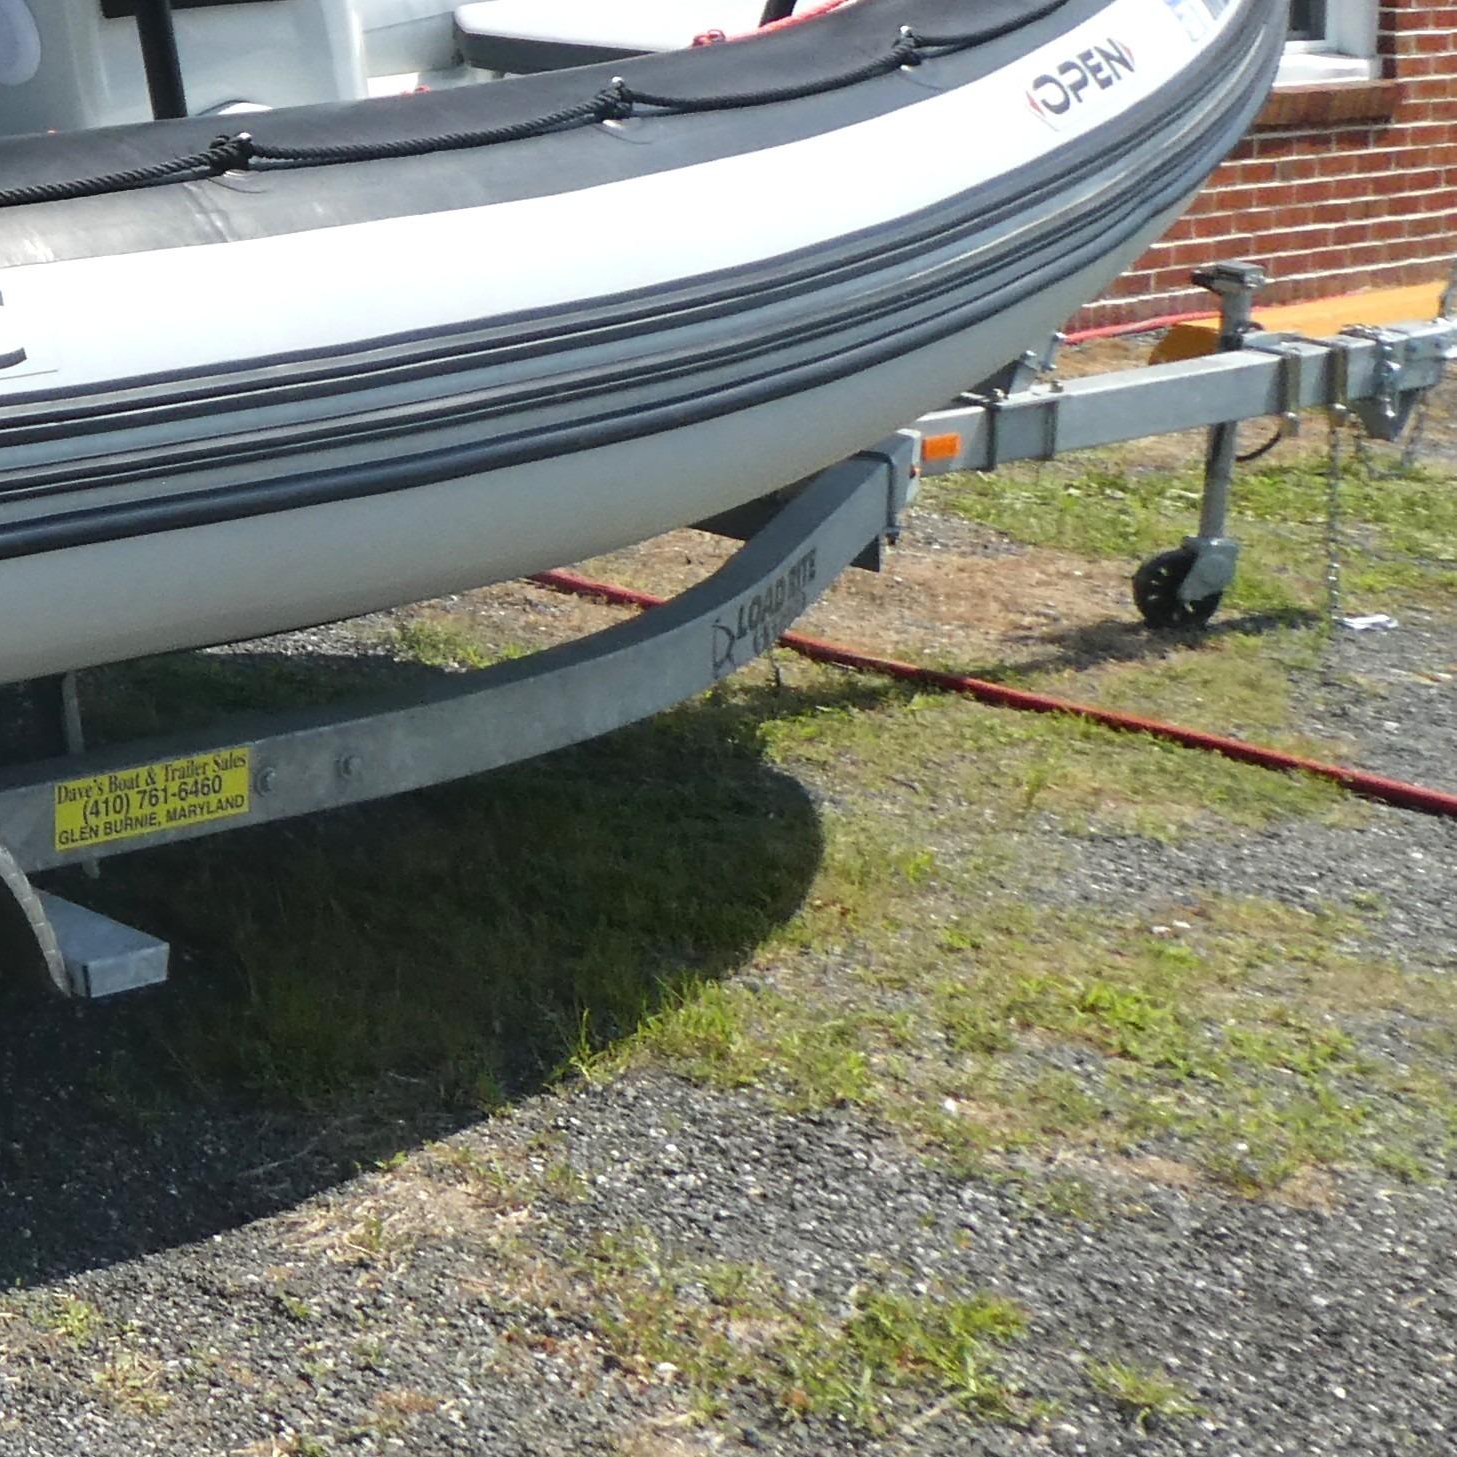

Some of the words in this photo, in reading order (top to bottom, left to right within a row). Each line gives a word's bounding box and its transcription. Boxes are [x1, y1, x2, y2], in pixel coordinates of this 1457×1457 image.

[1032, 37, 1135, 115] OPEN
[56, 779, 104, 805] Dave's
[108, 772, 140, 795] Boat
[144, 767, 157, 787] &
[163, 758, 208, 784] Trailer
[213, 751, 247, 770] Sales
[82, 792, 131, 825] (410)
[138, 774, 223, 810] 761-6460
[58, 824, 99, 846] GLEN
[103, 811, 162, 837] BURNIE,
[165, 793, 245, 822] MARYLAND
